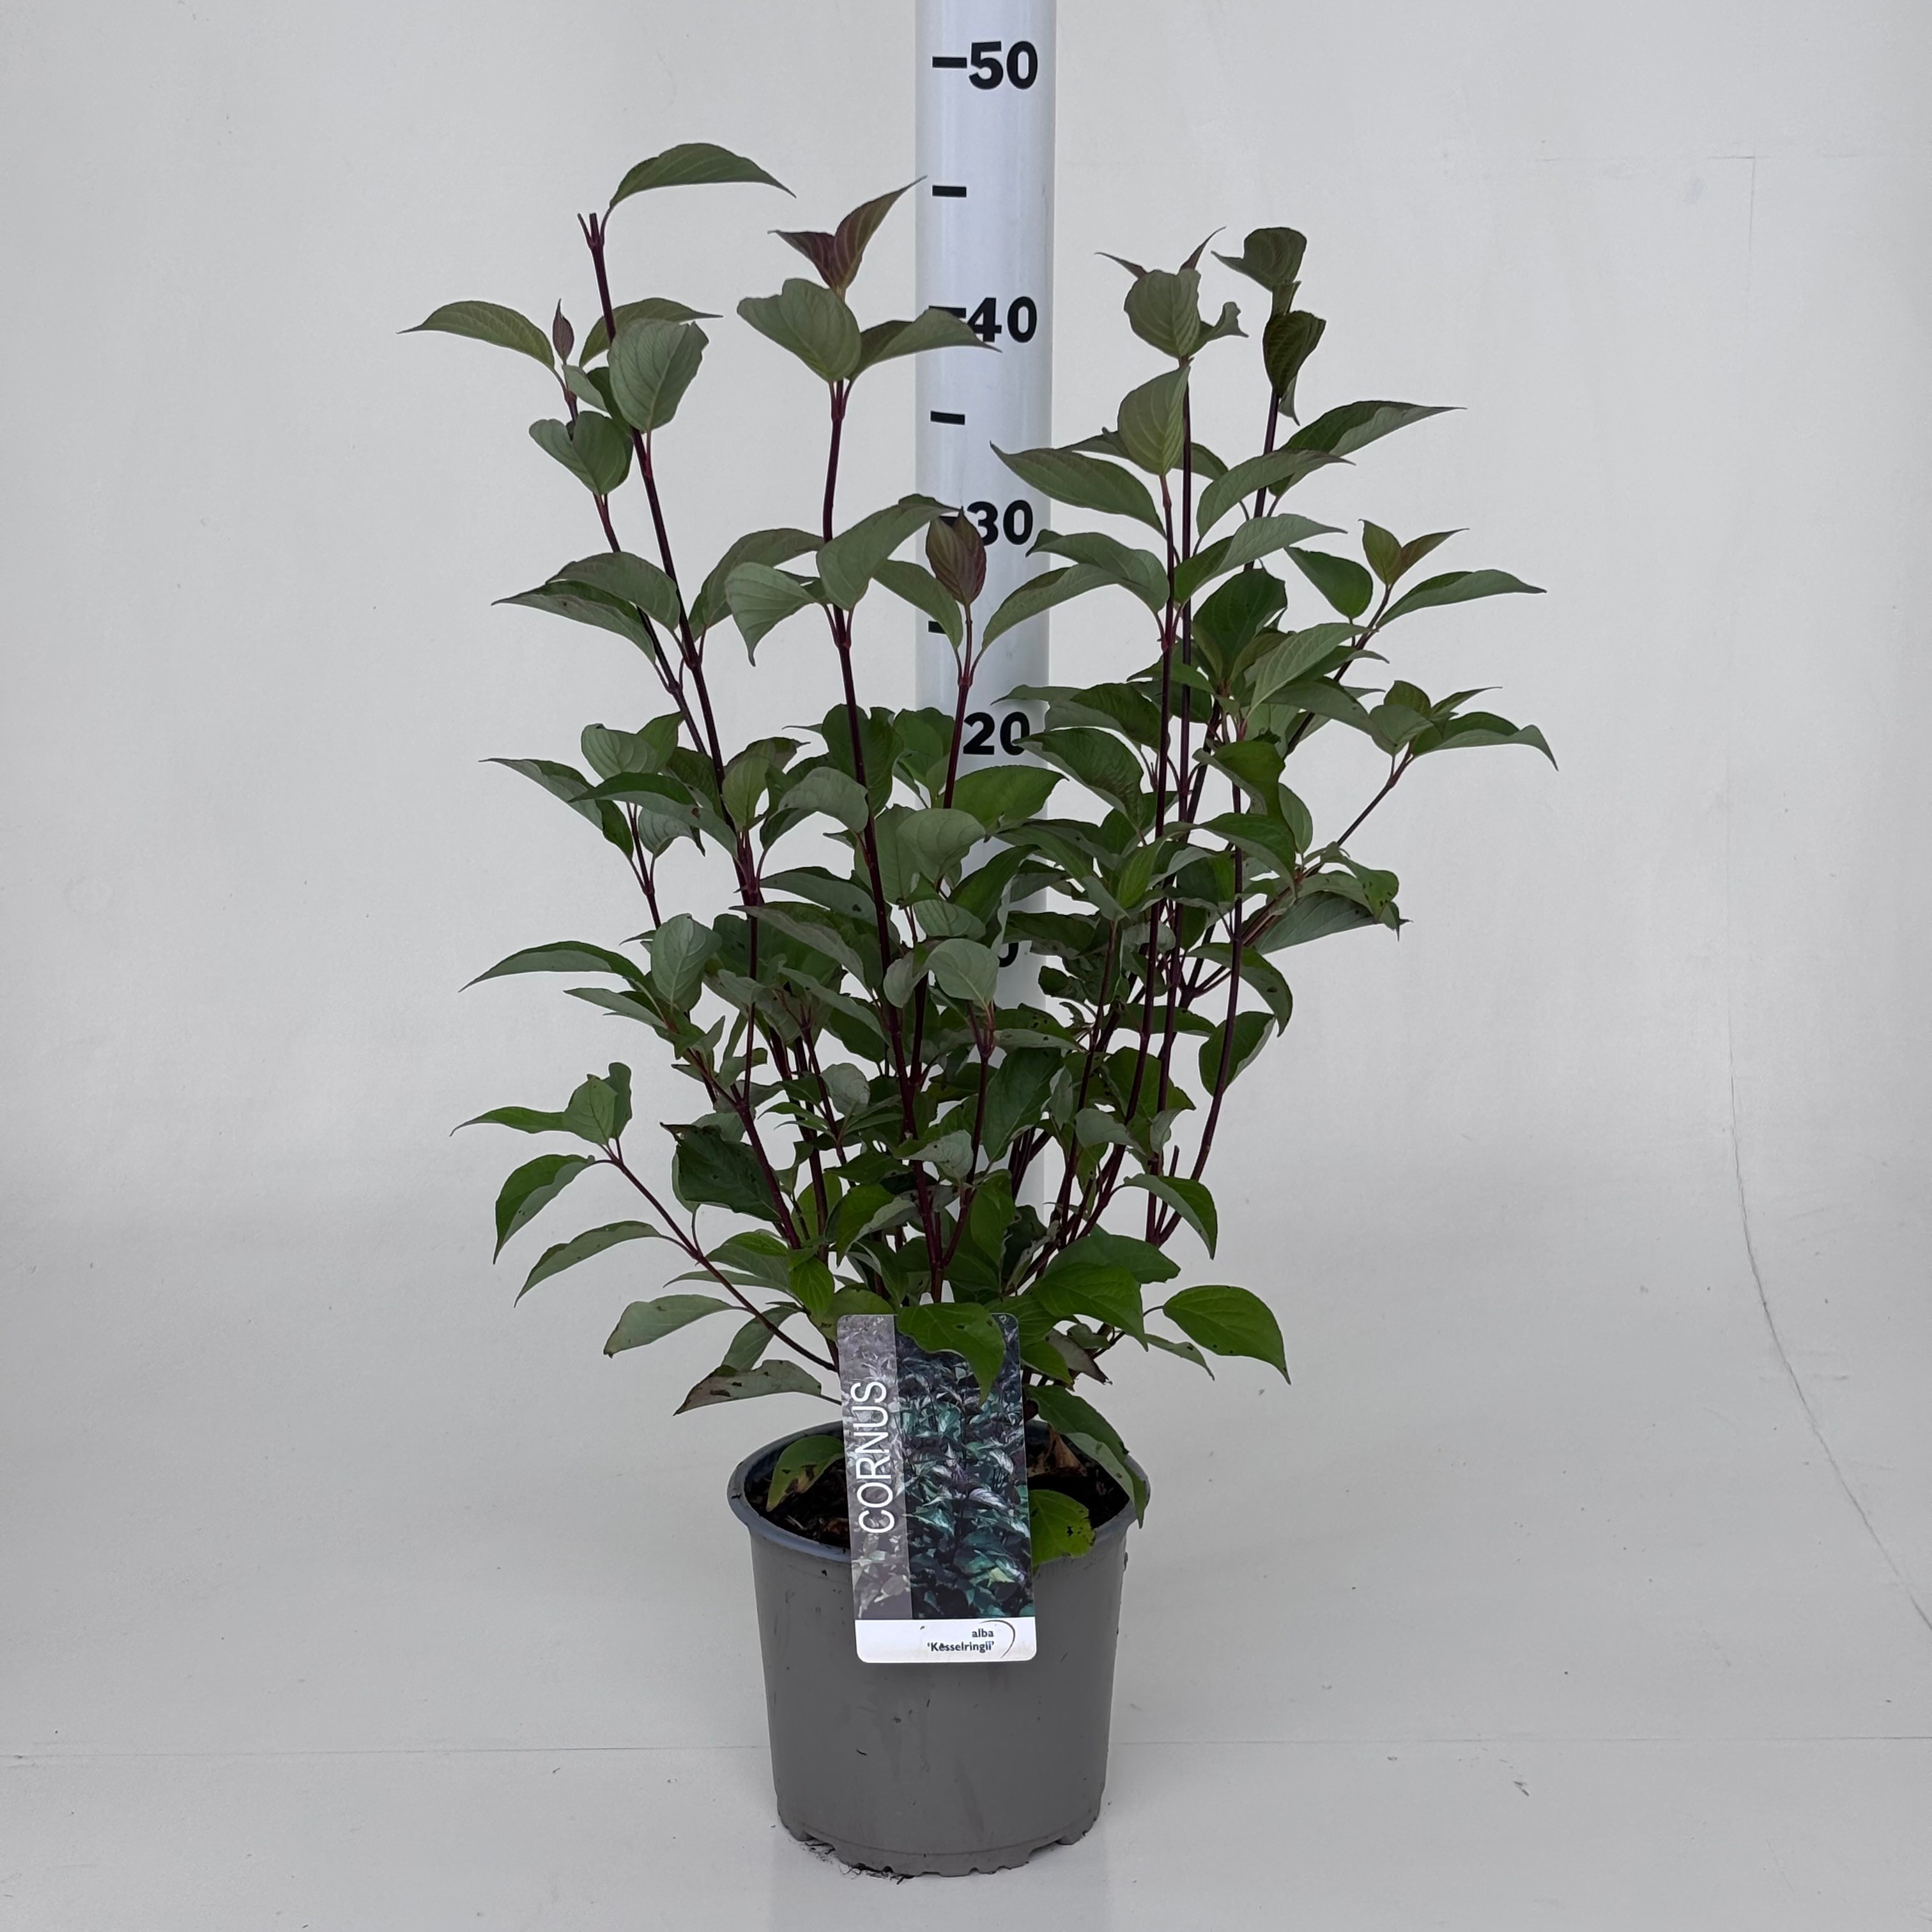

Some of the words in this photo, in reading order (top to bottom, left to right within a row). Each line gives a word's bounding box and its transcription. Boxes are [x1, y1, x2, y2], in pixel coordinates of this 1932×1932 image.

[969, 41, 1039, 91] 50
[967, 296, 1038, 344] 40
[967, 500, 1034, 547] 30
[963, 711, 1031, 756] 20
[850, 1381, 896, 1534] CORNUS
[972, 1628, 994, 1638] alba
